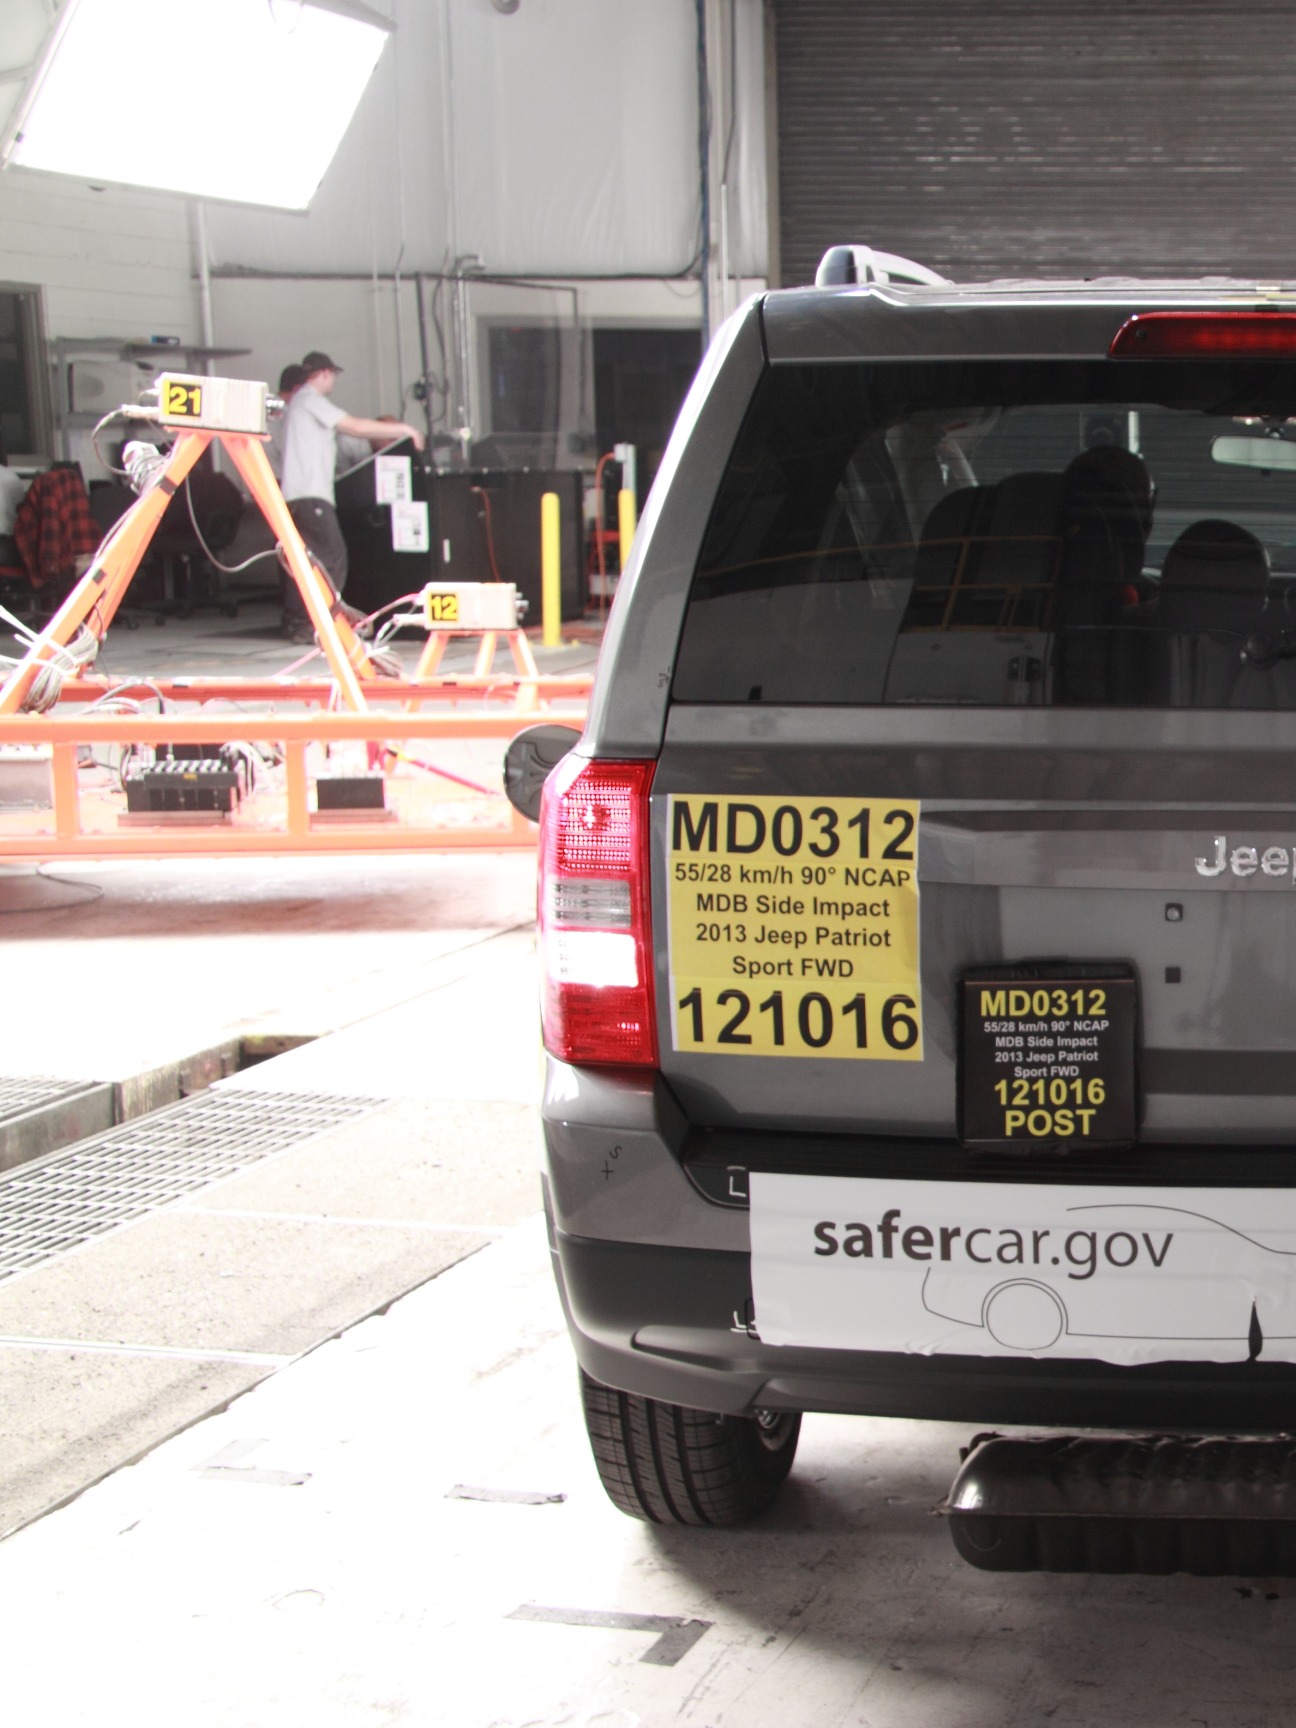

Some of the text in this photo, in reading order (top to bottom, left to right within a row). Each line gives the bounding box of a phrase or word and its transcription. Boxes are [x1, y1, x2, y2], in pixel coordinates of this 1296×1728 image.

[169, 386, 201, 415] 21
[431, 595, 457, 620] 12
[672, 801, 914, 860] MD0312
[675, 863, 731, 882] 55/28
[740, 866, 793, 884] km/h
[845, 868, 910, 887] NCAP
[697, 893, 890, 920] MDB Side Impact
[696, 923, 891, 949] 2013 Jeep Patriot
[733, 956, 854, 978] Sport FWD
[980, 989, 1106, 1016] MD0312
[679, 988, 918, 1050] 121016
[984, 1021, 1015, 1032] 55/28
[1018, 1021, 1048, 1032] km/h
[1073, 1020, 1109, 1031] NCAP
[995, 1036, 1098, 1048] MDB Side Impact
[995, 1050, 1098, 1064] 2013 Jeep Patriot
[1014, 1066, 1079, 1079] Sport FWD
[994, 1078, 1106, 1106] 121016
[1005, 1109, 1096, 1136] POST
[813, 1210, 1174, 1280] safercar.gov
